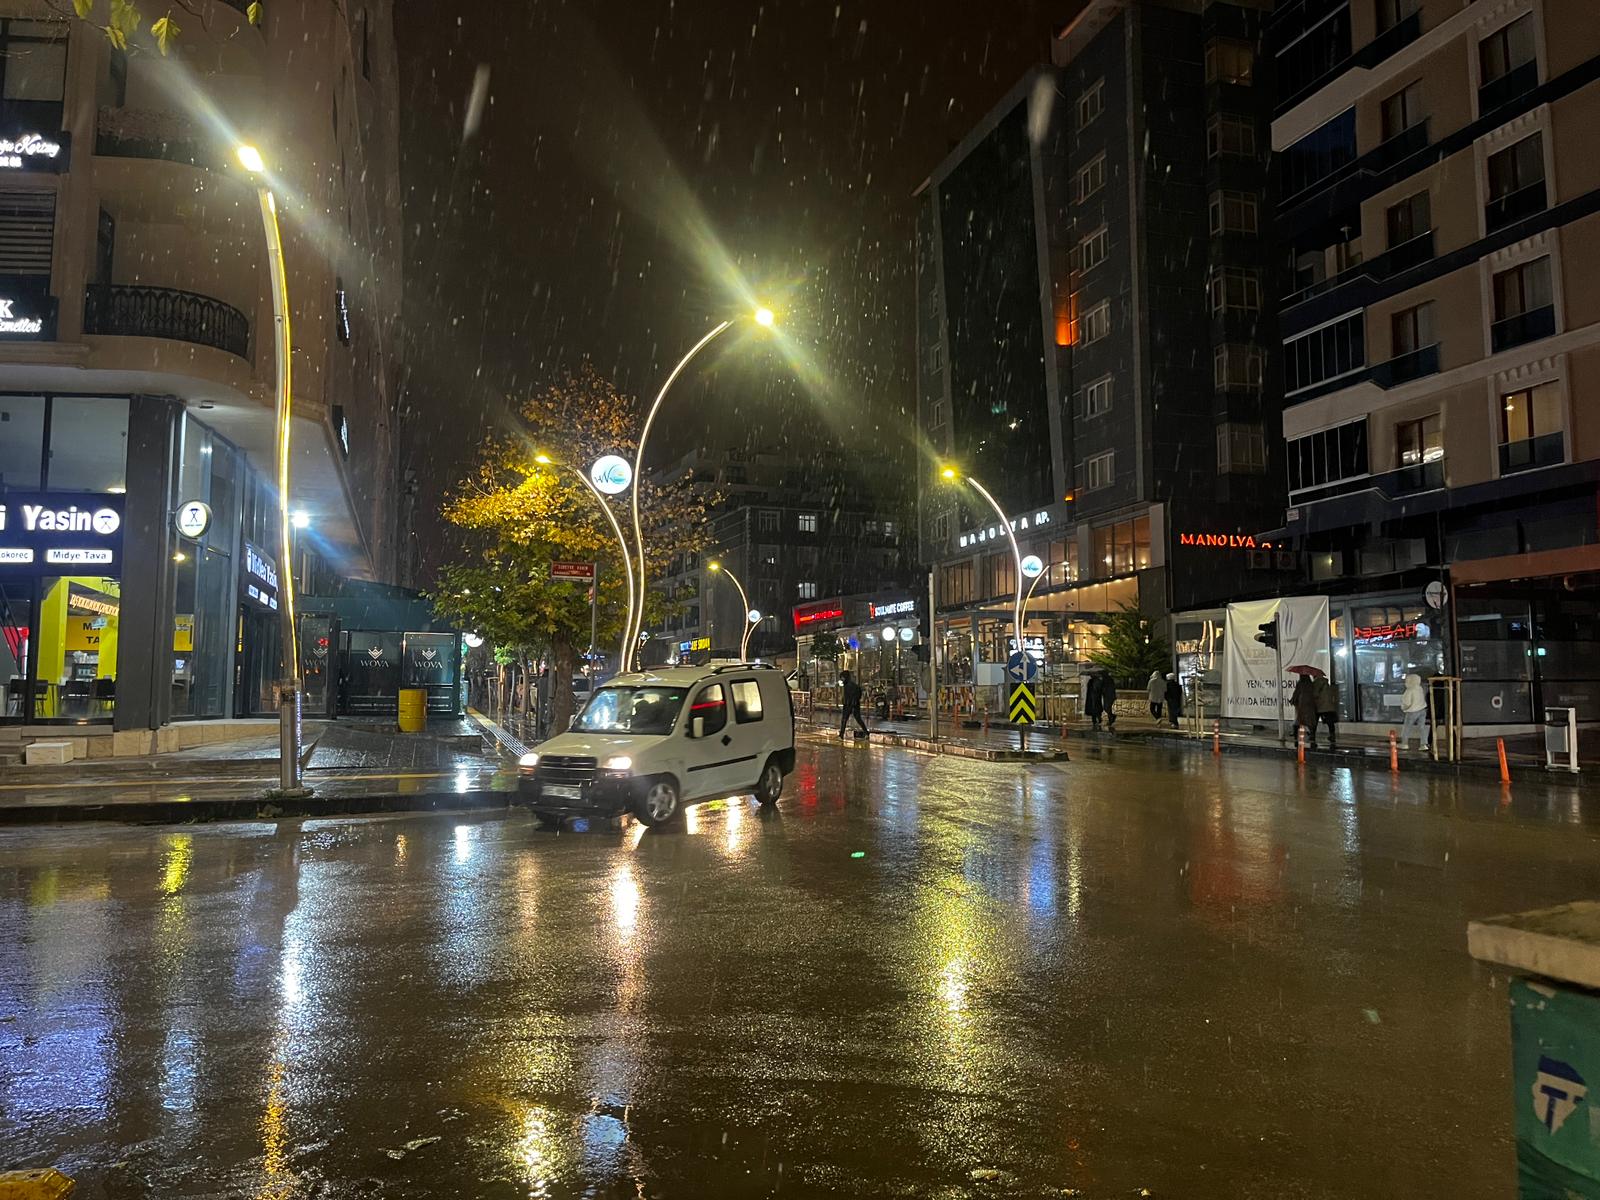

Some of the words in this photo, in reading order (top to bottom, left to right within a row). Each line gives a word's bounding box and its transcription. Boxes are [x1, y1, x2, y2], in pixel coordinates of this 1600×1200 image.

[23, 505, 92, 531] Yasin
[1180, 533, 1256, 548] MANOLYA
[0, 551, 29, 559] okoreç
[53, 551, 81, 561] Midye
[85, 551, 107, 559] Tava
[360, 660, 390, 668] WOVA
[414, 660, 443, 669] WOVA
